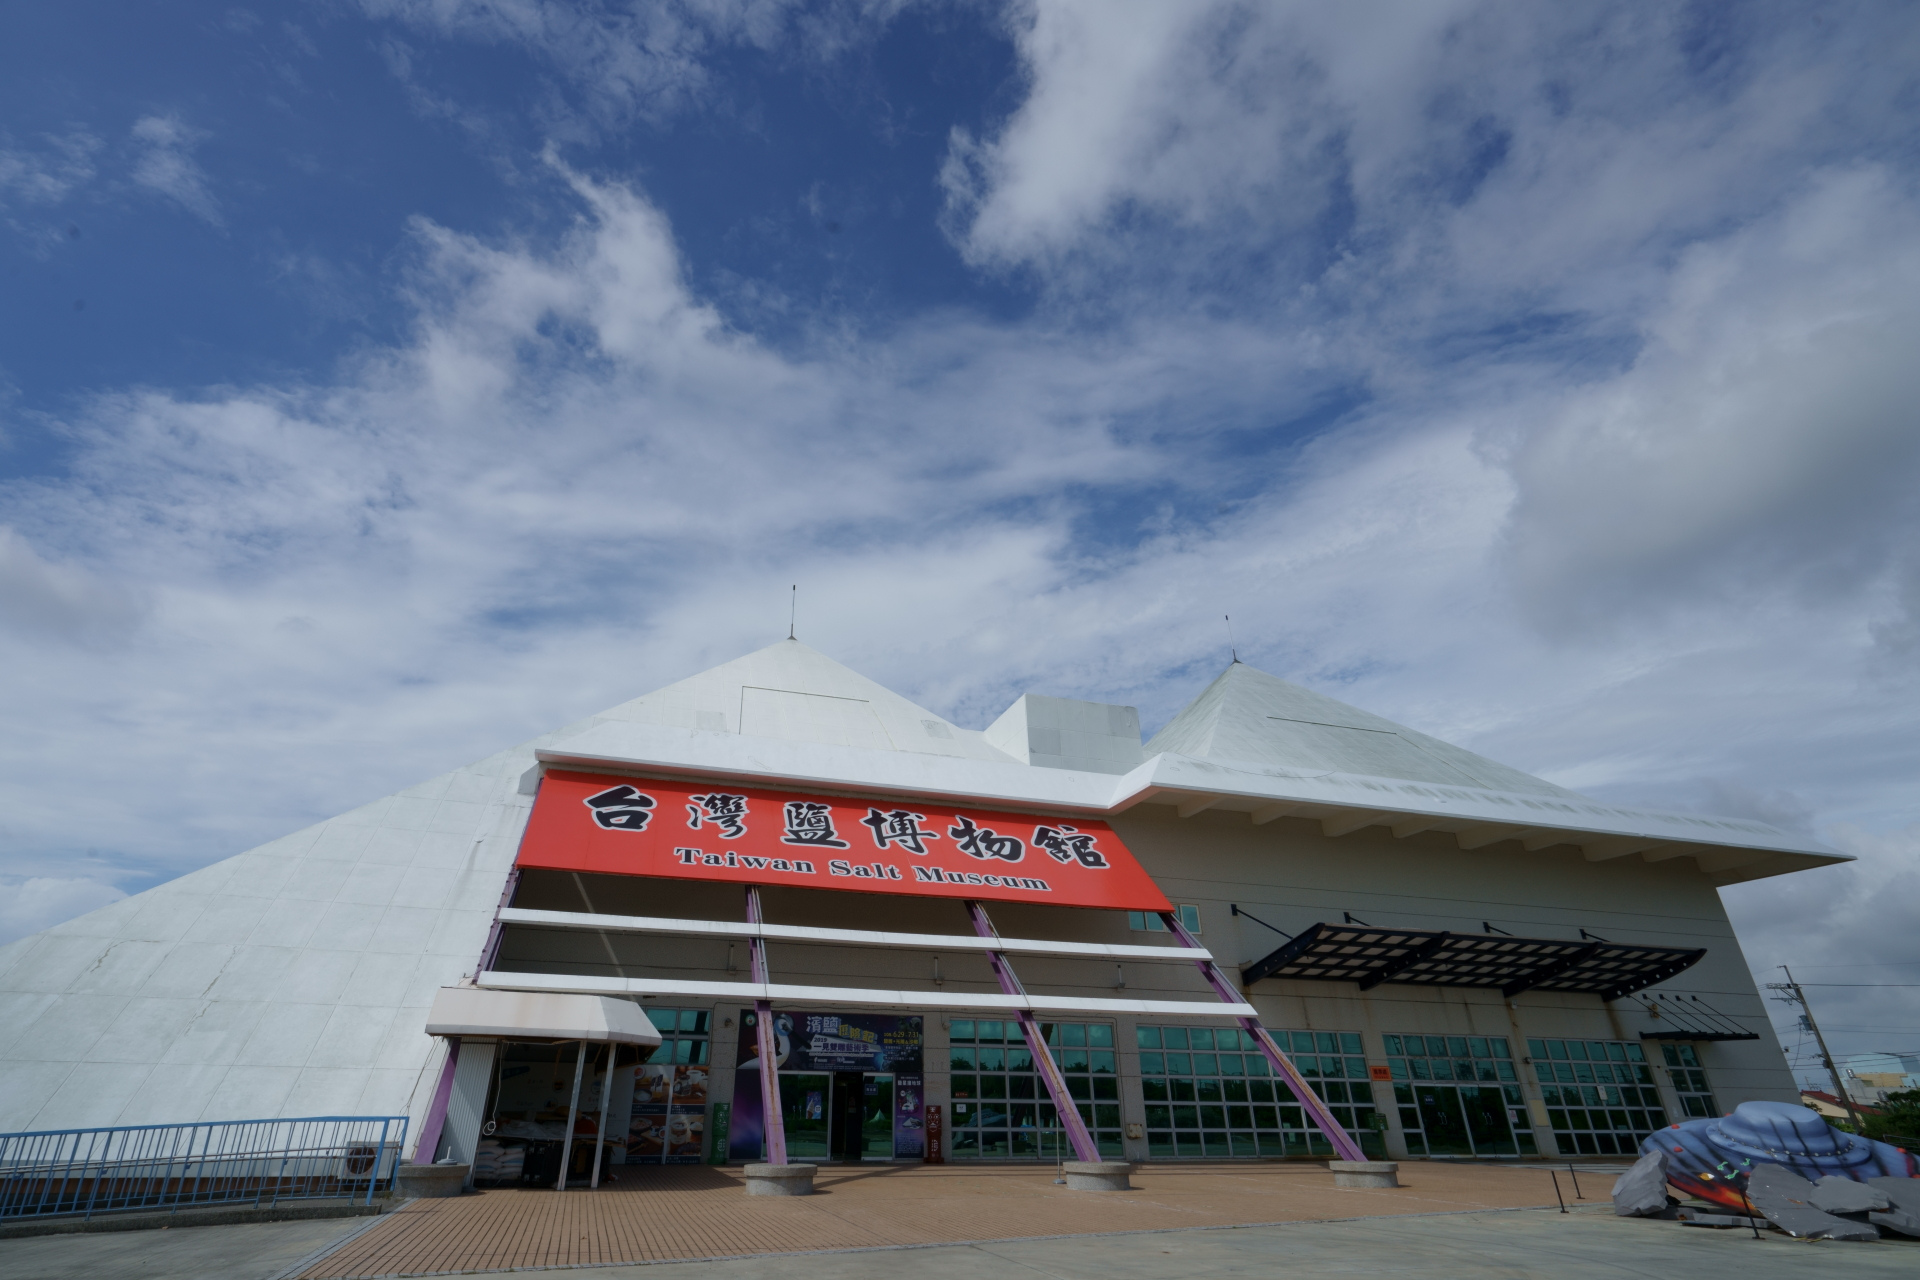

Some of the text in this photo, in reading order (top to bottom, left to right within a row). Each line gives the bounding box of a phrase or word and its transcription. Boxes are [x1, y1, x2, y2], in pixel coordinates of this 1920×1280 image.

[584, 785, 1111, 869] 台灣鹽博物館
[674, 848, 1052, 892] Taiwan Salt Museum
